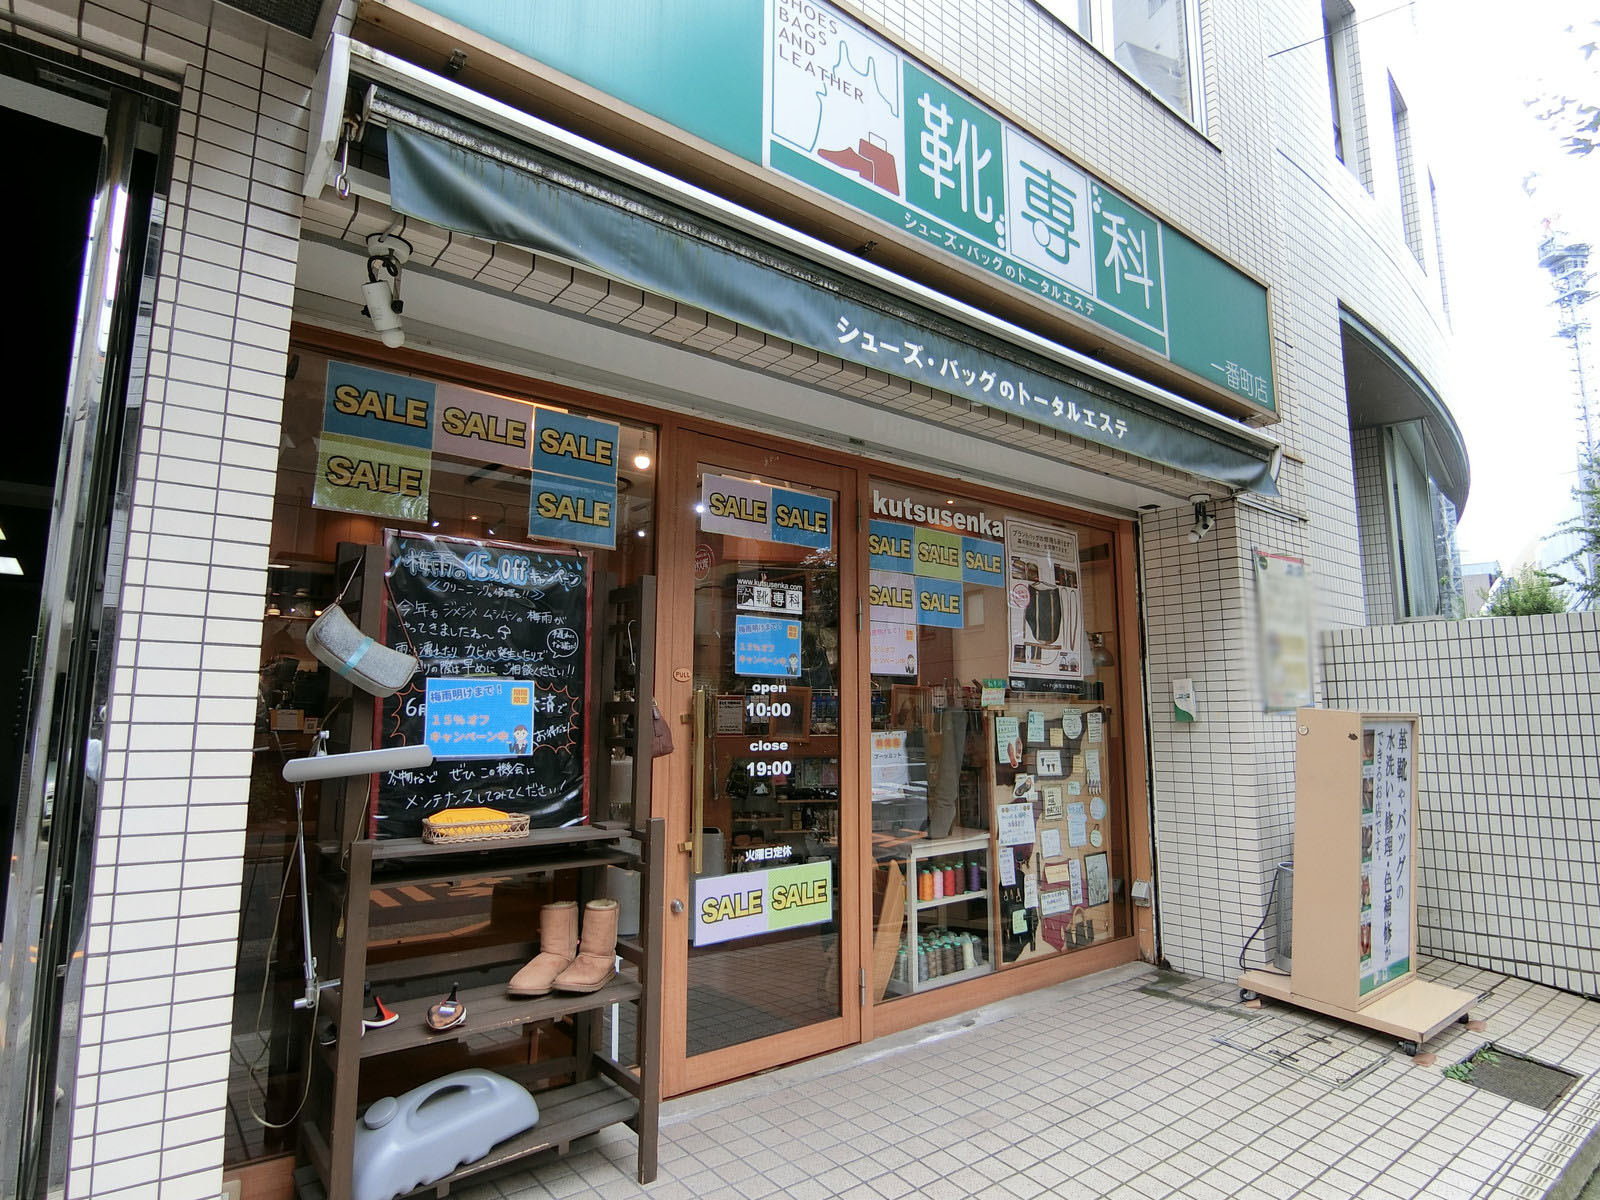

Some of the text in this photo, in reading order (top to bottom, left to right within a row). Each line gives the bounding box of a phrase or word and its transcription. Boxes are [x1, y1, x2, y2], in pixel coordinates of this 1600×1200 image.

[778, 27, 815, 56] AND
[779, 6, 827, 46] BAGS
[779, 43, 864, 104] LEATHER
[917, 92, 1154, 310] 靴専科
[904, 212, 1095, 316] シューズ・バッグのトータルエステ
[836, 316, 1128, 440] シューズ・バッグのトータルエステ
[1210, 360, 1268, 403] 一番町店
[334, 384, 429, 429] SALE
[442, 407, 526, 449] SALE
[540, 428, 613, 466] SALE
[326, 456, 422, 498] SALE
[536, 492, 611, 528] SALE
[709, 493, 768, 524] SALE
[775, 505, 828, 534] SALE
[872, 489, 1004, 538] kutsusenka
[868, 533, 911, 559] SALE
[918, 541, 959, 568] SALE
[965, 551, 1001, 574] SALE
[737, 578, 802, 591] www.kutsusenka.com
[869, 585, 913, 609] SALE
[920, 591, 960, 614] SALE
[430, 684, 502, 703] 梅雨明けまで!
[752, 683, 787, 695] open
[746, 702, 791, 717] 10:00
[749, 740, 788, 751] close
[746, 761, 792, 776] 19:00
[745, 845, 792, 862] 火曜日定休
[702, 888, 763, 924] SALE
[771, 878, 828, 910] SALE
